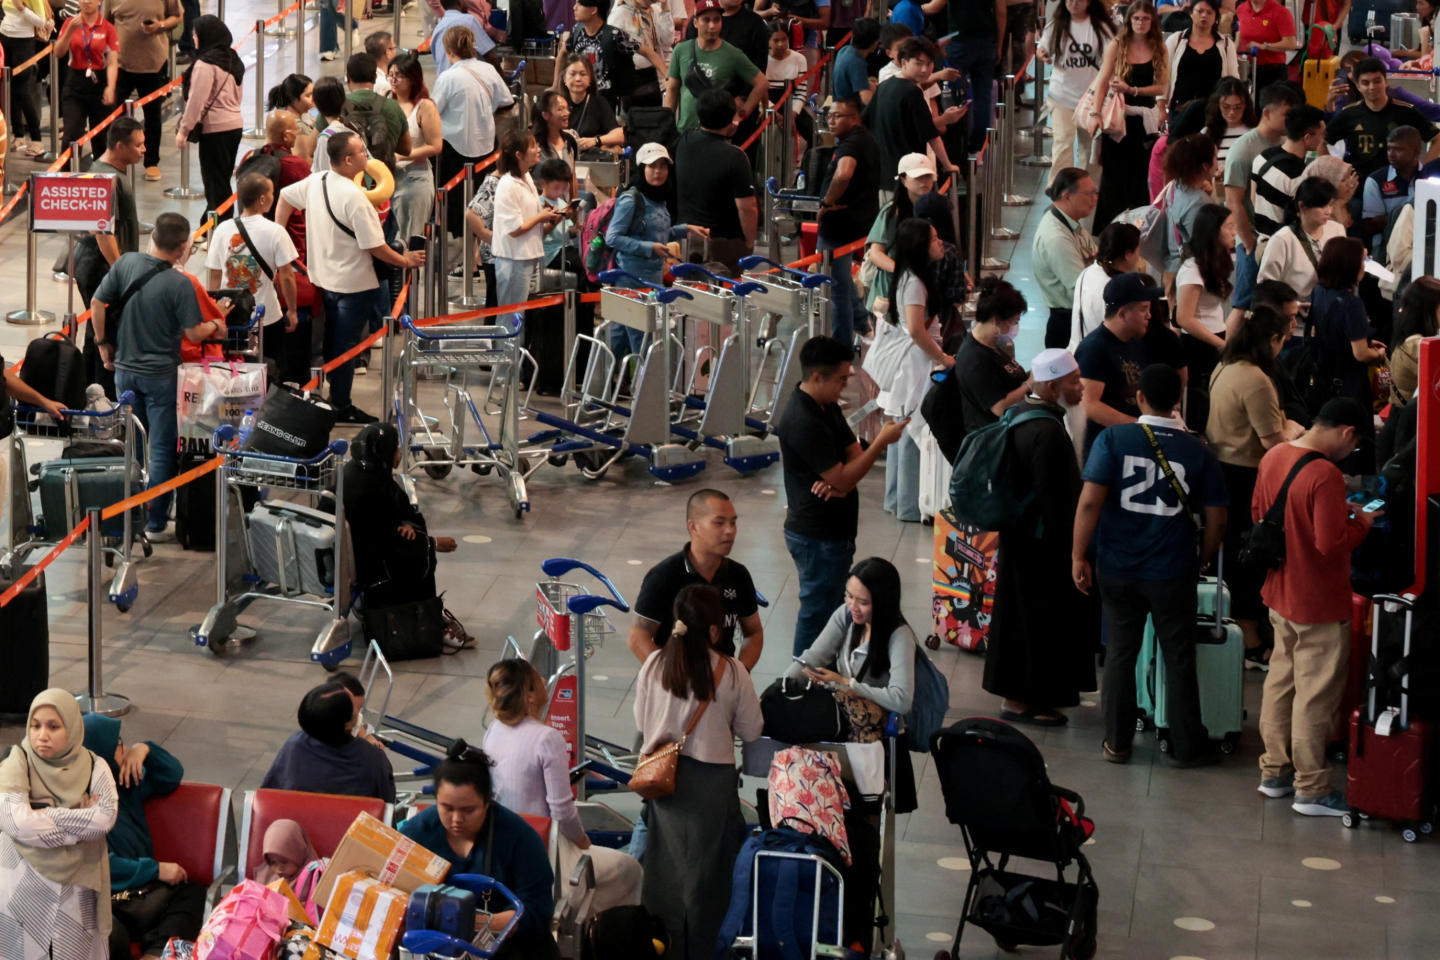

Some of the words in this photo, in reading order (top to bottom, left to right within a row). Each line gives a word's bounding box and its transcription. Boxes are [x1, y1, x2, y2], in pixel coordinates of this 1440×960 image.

[41, 186, 108, 198] ASSISTED
[40, 199, 107, 210] CHECK-IN
[1120, 454, 1190, 517] 23
